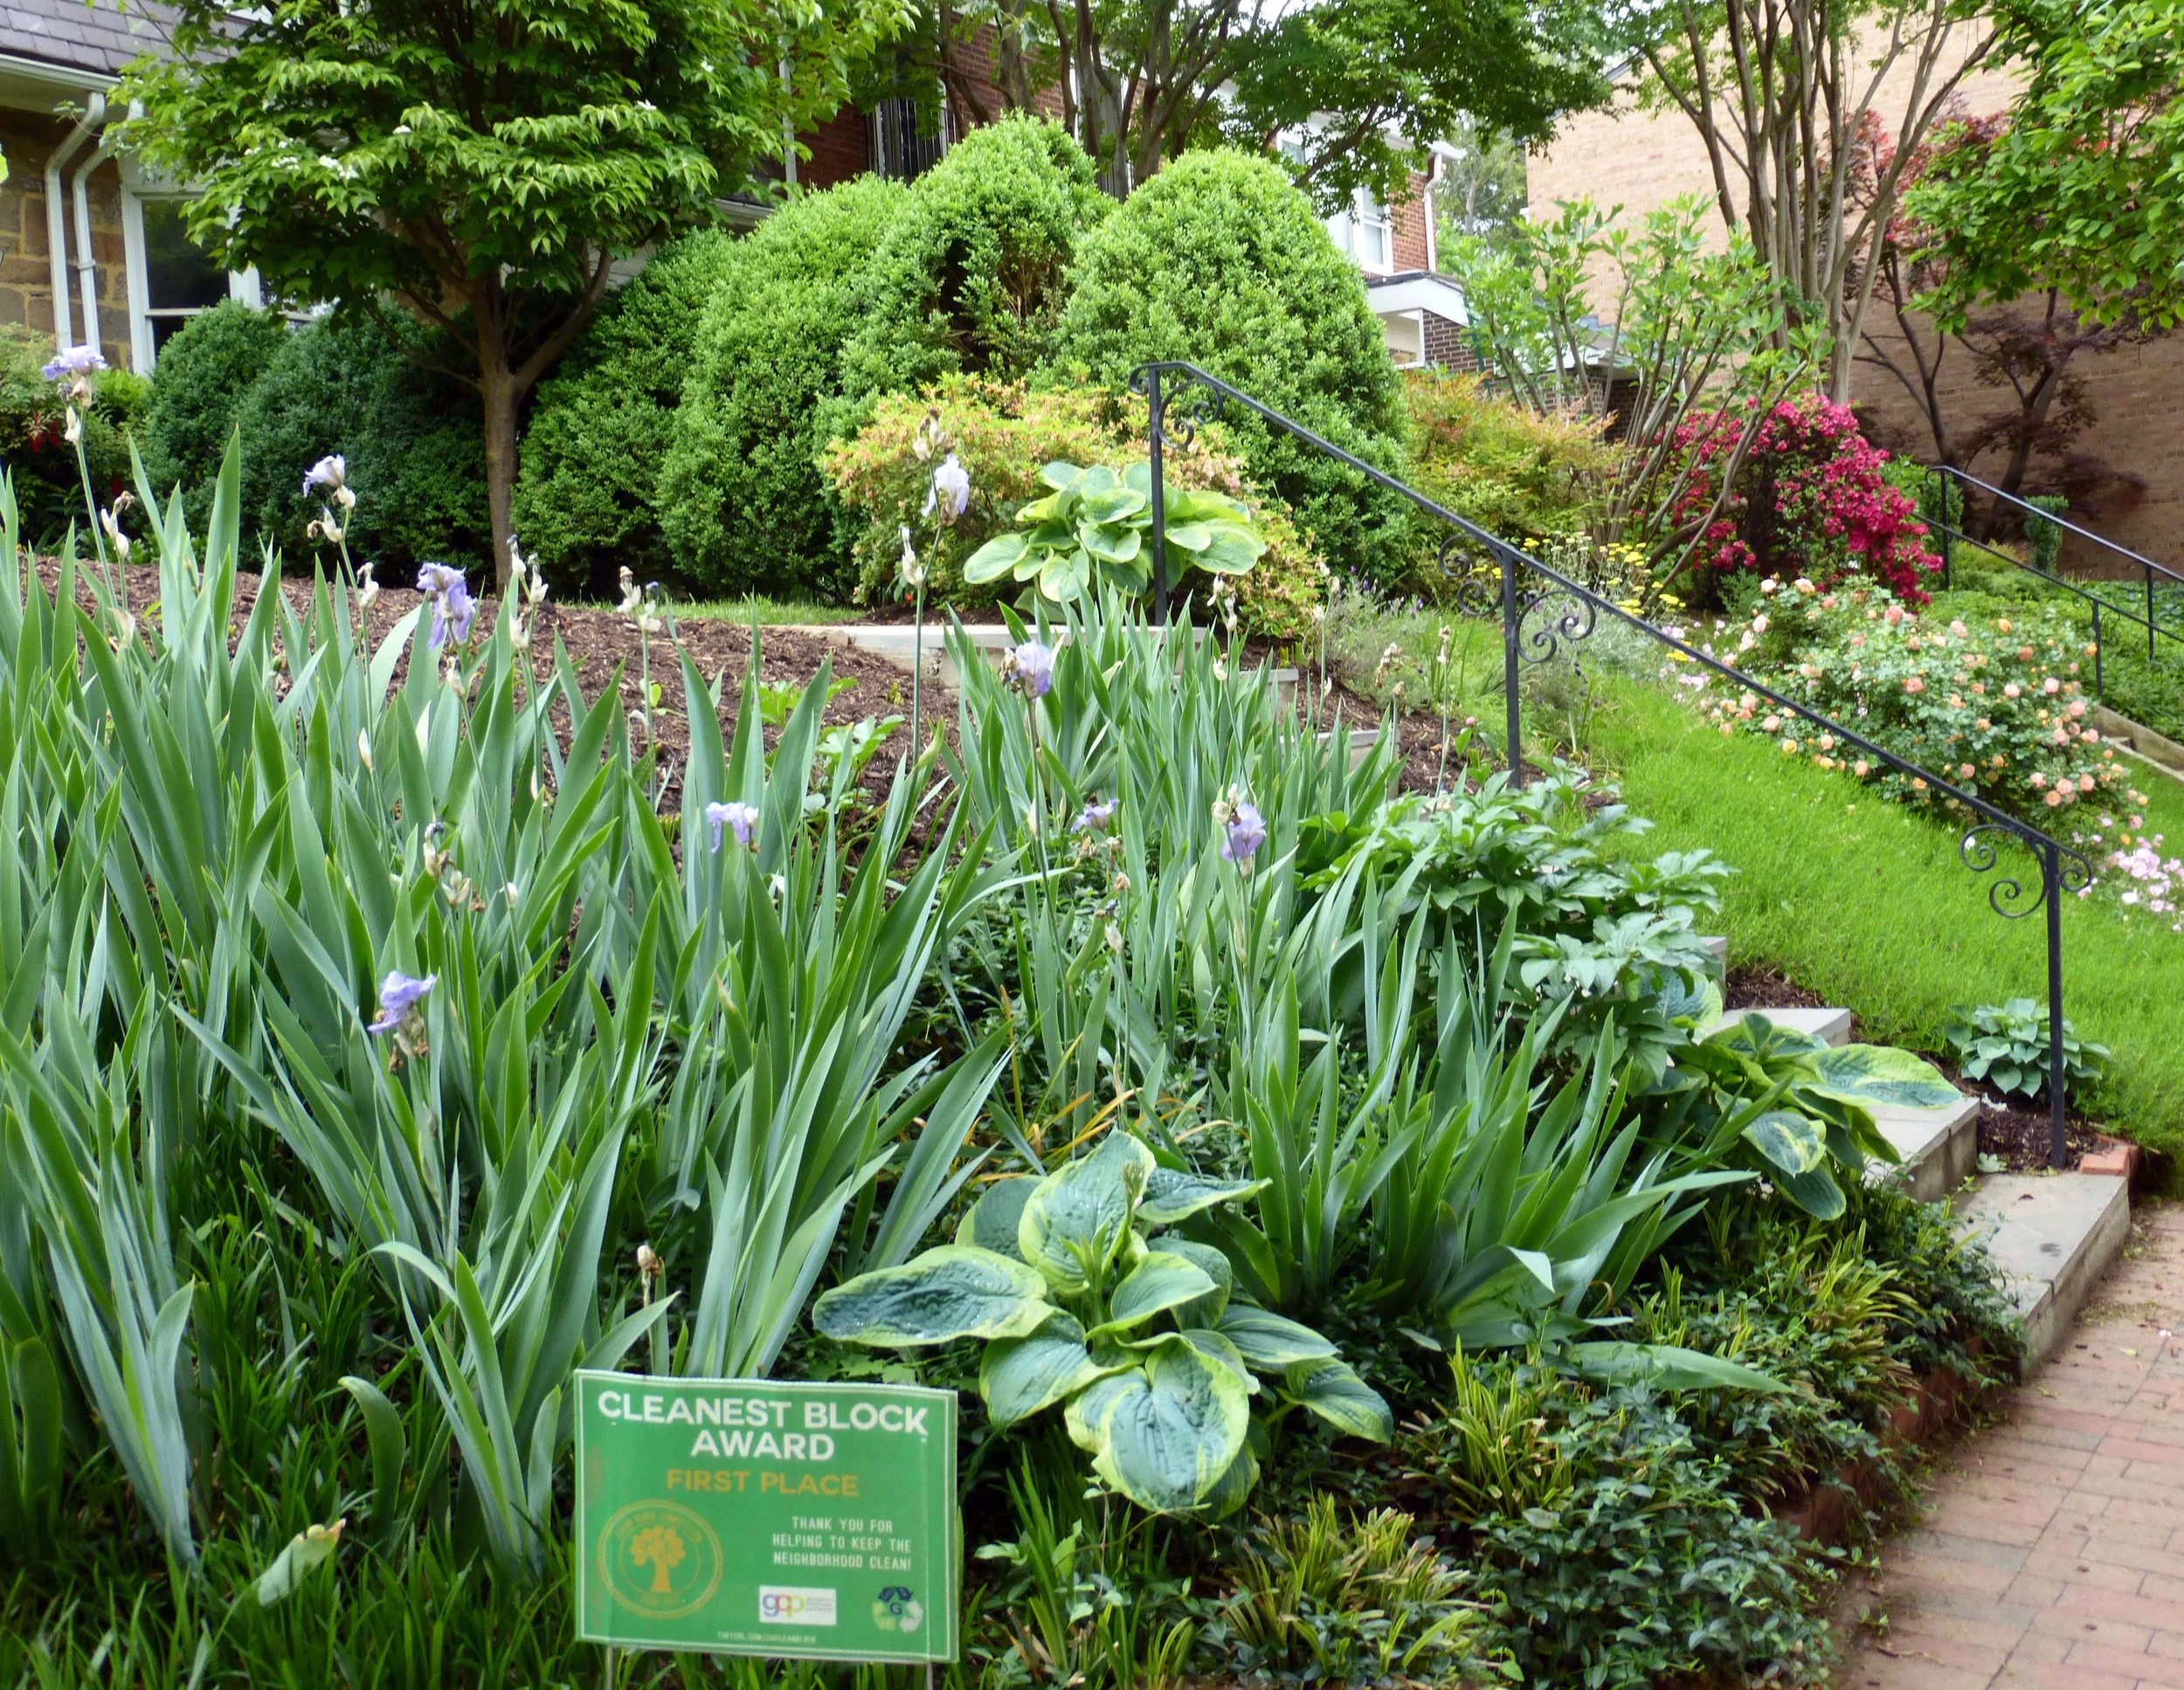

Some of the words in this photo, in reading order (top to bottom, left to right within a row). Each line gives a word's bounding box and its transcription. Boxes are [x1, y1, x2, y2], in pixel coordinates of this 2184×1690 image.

[598, 1390, 791, 1427] CLEANEST
[805, 1402, 929, 1436] BLOCK
[690, 1430, 835, 1461] AWARD
[667, 1469, 751, 1493] FIRST
[761, 1472, 860, 1496] PLACE
[791, 1516, 832, 1530] THANK
[840, 1518, 864, 1532] YOU
[870, 1519, 893, 1534] FOR
[772, 1533, 822, 1548] HELPING
[830, 1536, 846, 1549] TO
[851, 1537, 882, 1551] KEEP
[889, 1539, 911, 1554] THE
[773, 1551, 863, 1568] NEIGHBORHOOD
